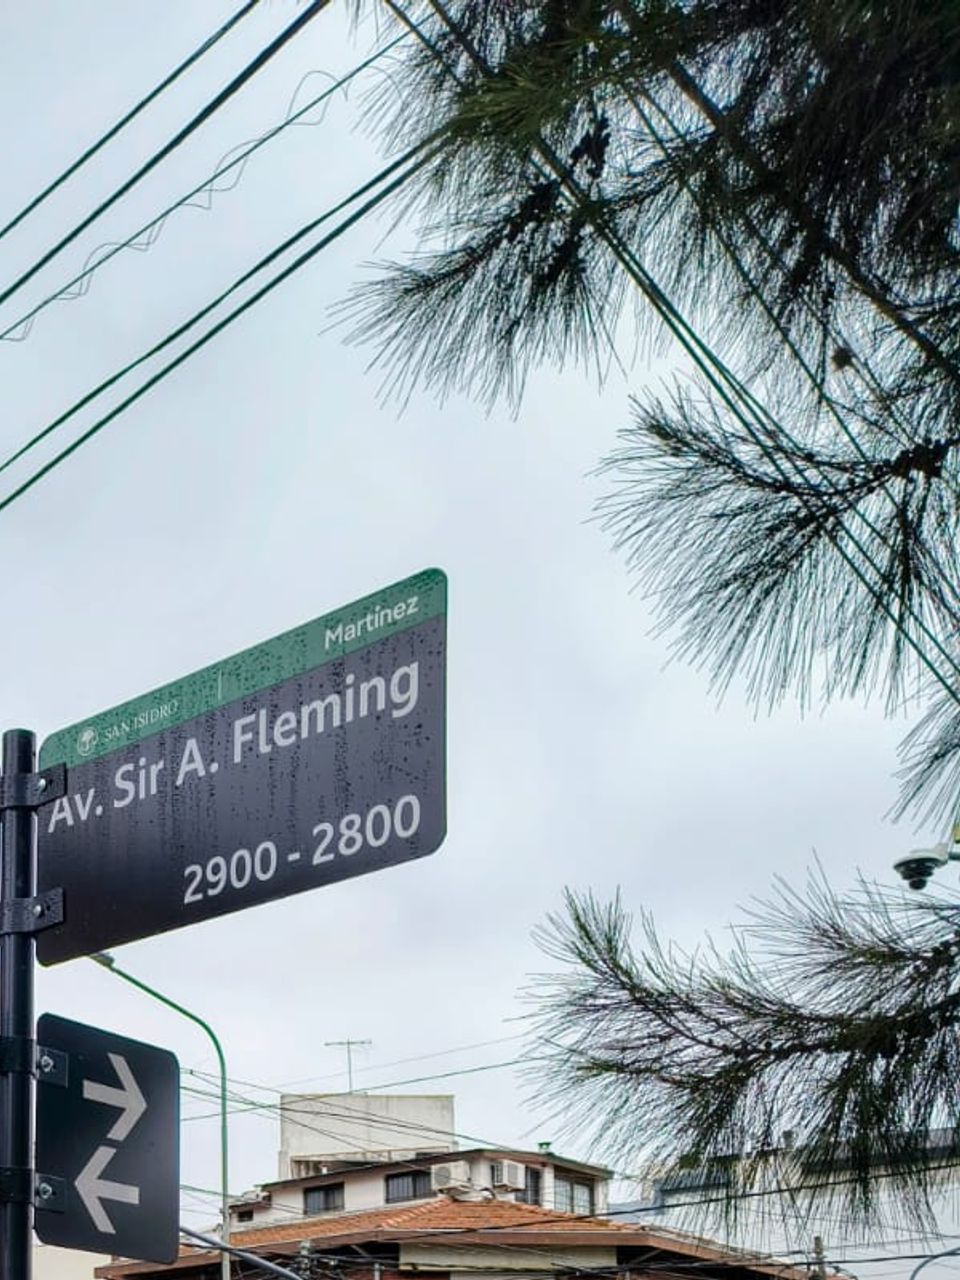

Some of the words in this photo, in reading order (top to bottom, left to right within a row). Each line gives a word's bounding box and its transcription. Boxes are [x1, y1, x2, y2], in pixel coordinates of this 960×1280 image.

[324, 595, 420, 650] Martínez
[47, 788, 104, 833] Av.
[113, 756, 165, 808] Sir
[175, 738, 219, 786] A.
[232, 661, 420, 764] Fleming
[104, 722, 130, 742] SAN
[133, 700, 178, 729] ISIDRO
[183, 841, 277, 905] 2900
[312, 794, 421, 865] 2800
